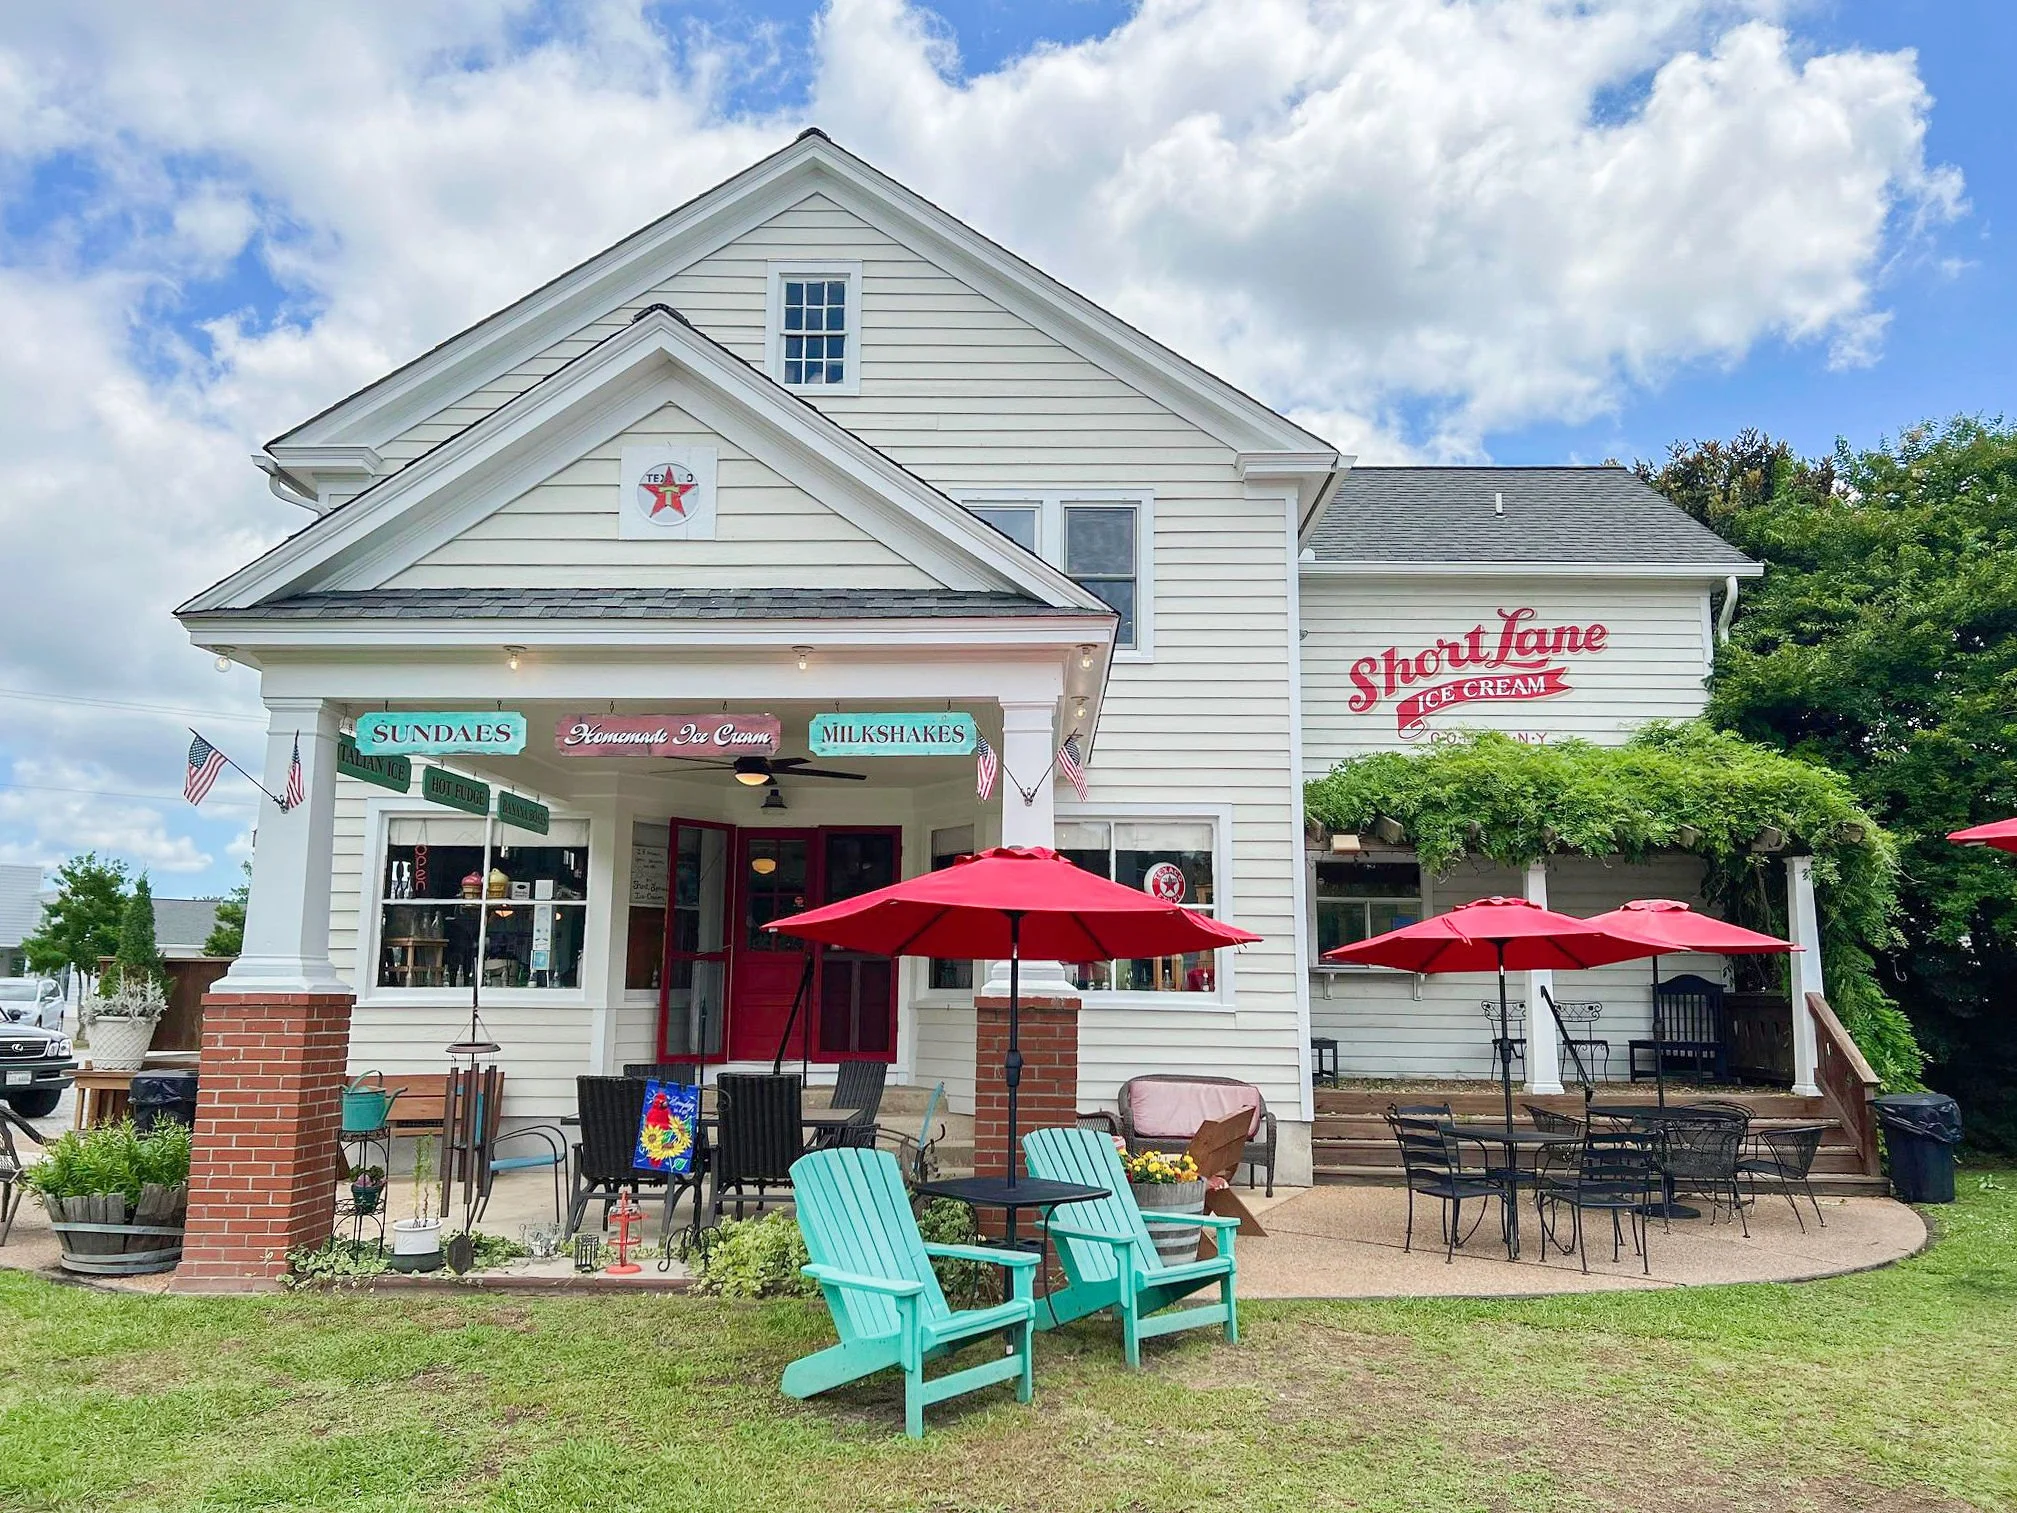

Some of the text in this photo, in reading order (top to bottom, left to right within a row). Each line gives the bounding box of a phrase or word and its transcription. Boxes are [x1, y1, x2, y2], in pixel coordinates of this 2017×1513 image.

[646, 473, 693, 483] TEXO
[1348, 607, 1608, 713] Short Lane
[1417, 675, 1547, 714] ICE CREAM
[371, 723, 512, 743] SUNDAES
[563, 723, 773, 746] Homemade Ice Cream
[822, 724, 965, 743] MILKSHAKES
[1430, 731, 1548, 745] CONY
[387, 760, 405, 781] ICE
[432, 776, 485, 806] HOT FUDGE
[1153, 866, 1183, 882] TEXACO
